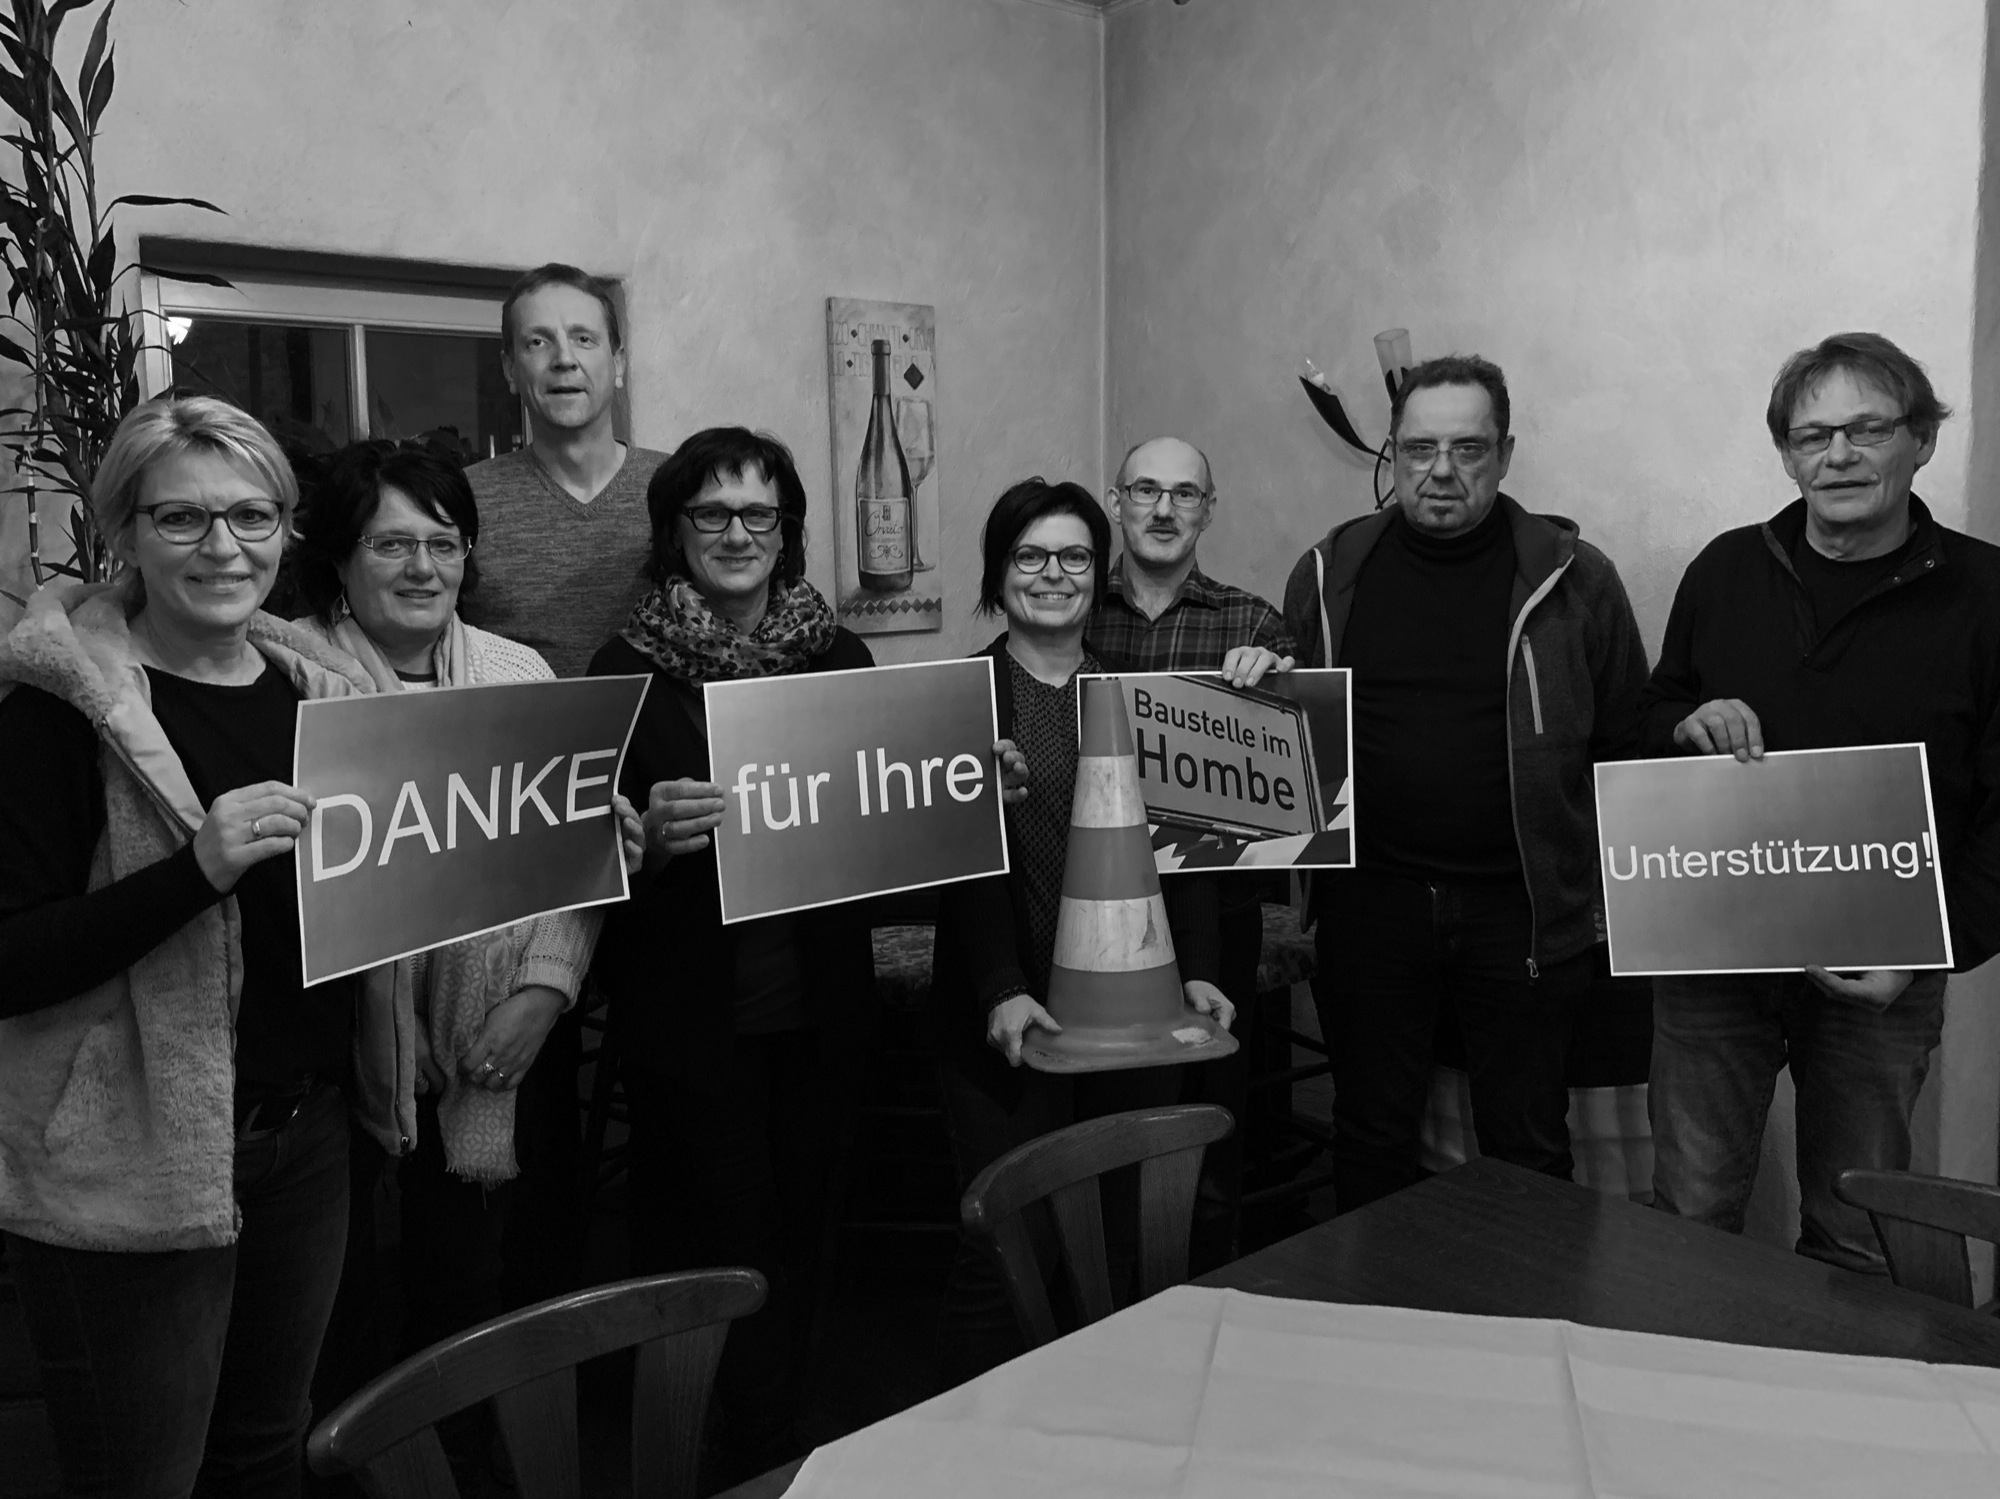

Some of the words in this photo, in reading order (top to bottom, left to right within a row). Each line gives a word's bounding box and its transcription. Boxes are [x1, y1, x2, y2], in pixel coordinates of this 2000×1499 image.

[1134, 687, 1256, 749] Baustelle
[1261, 726, 1291, 759] im
[732, 762, 831, 835] für
[856, 747, 984, 817] Ihre
[1136, 727, 1296, 811] Hombe
[311, 748, 618, 882] DANKE
[1607, 832, 1934, 881] Unterstützung!
